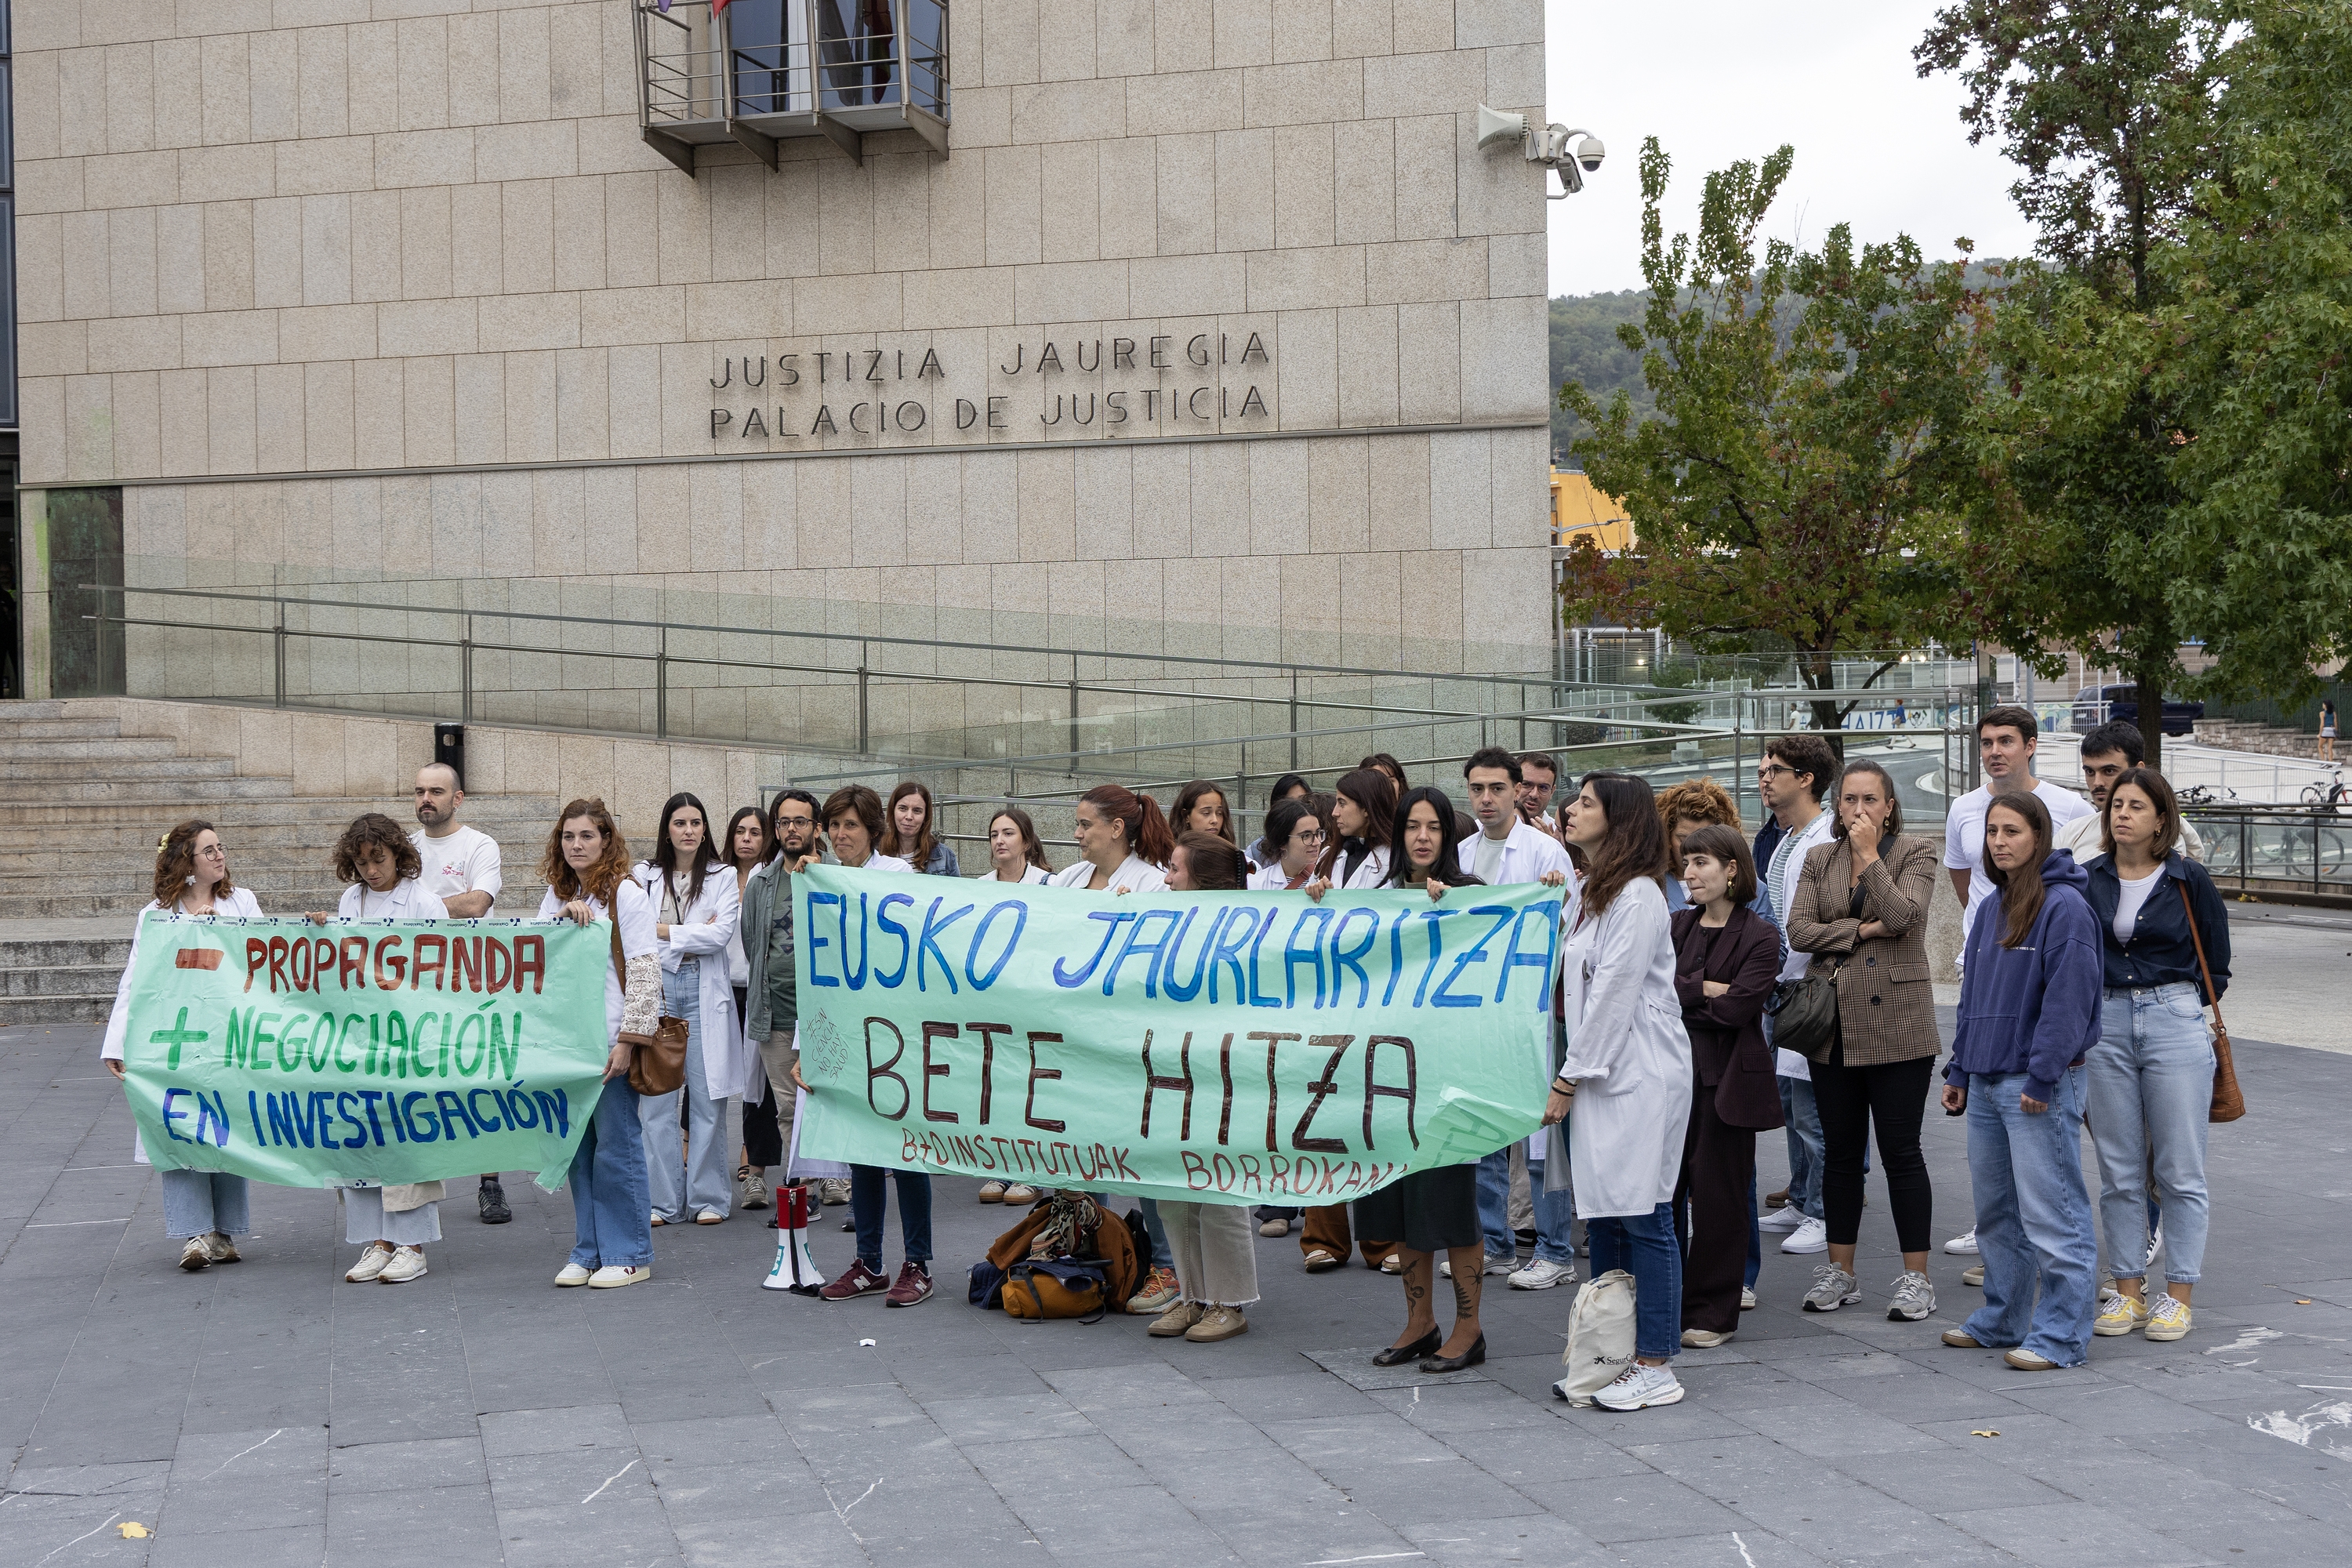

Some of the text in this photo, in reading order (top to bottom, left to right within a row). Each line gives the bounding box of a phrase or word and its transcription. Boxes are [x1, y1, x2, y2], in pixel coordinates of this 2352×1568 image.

[710, 332, 1269, 389] JUSTIZIA JAUREGIA
[710, 385, 1269, 439] PALACIO DE JUSTICIA
[243, 934, 546, 995] PROPAGANDA
[808, 891, 1561, 1013] EUSKO JAURLARITZA
[223, 999, 522, 1081] NEGOCIACIÓN
[811, 1021, 837, 1062] CIENCIA
[818, 1033, 842, 1075] NO HAY
[163, 1080, 568, 1149] EN INVESTIGACIÓN
[864, 1016, 1066, 1132] BETE
[1140, 1028, 1420, 1154] HITZA
